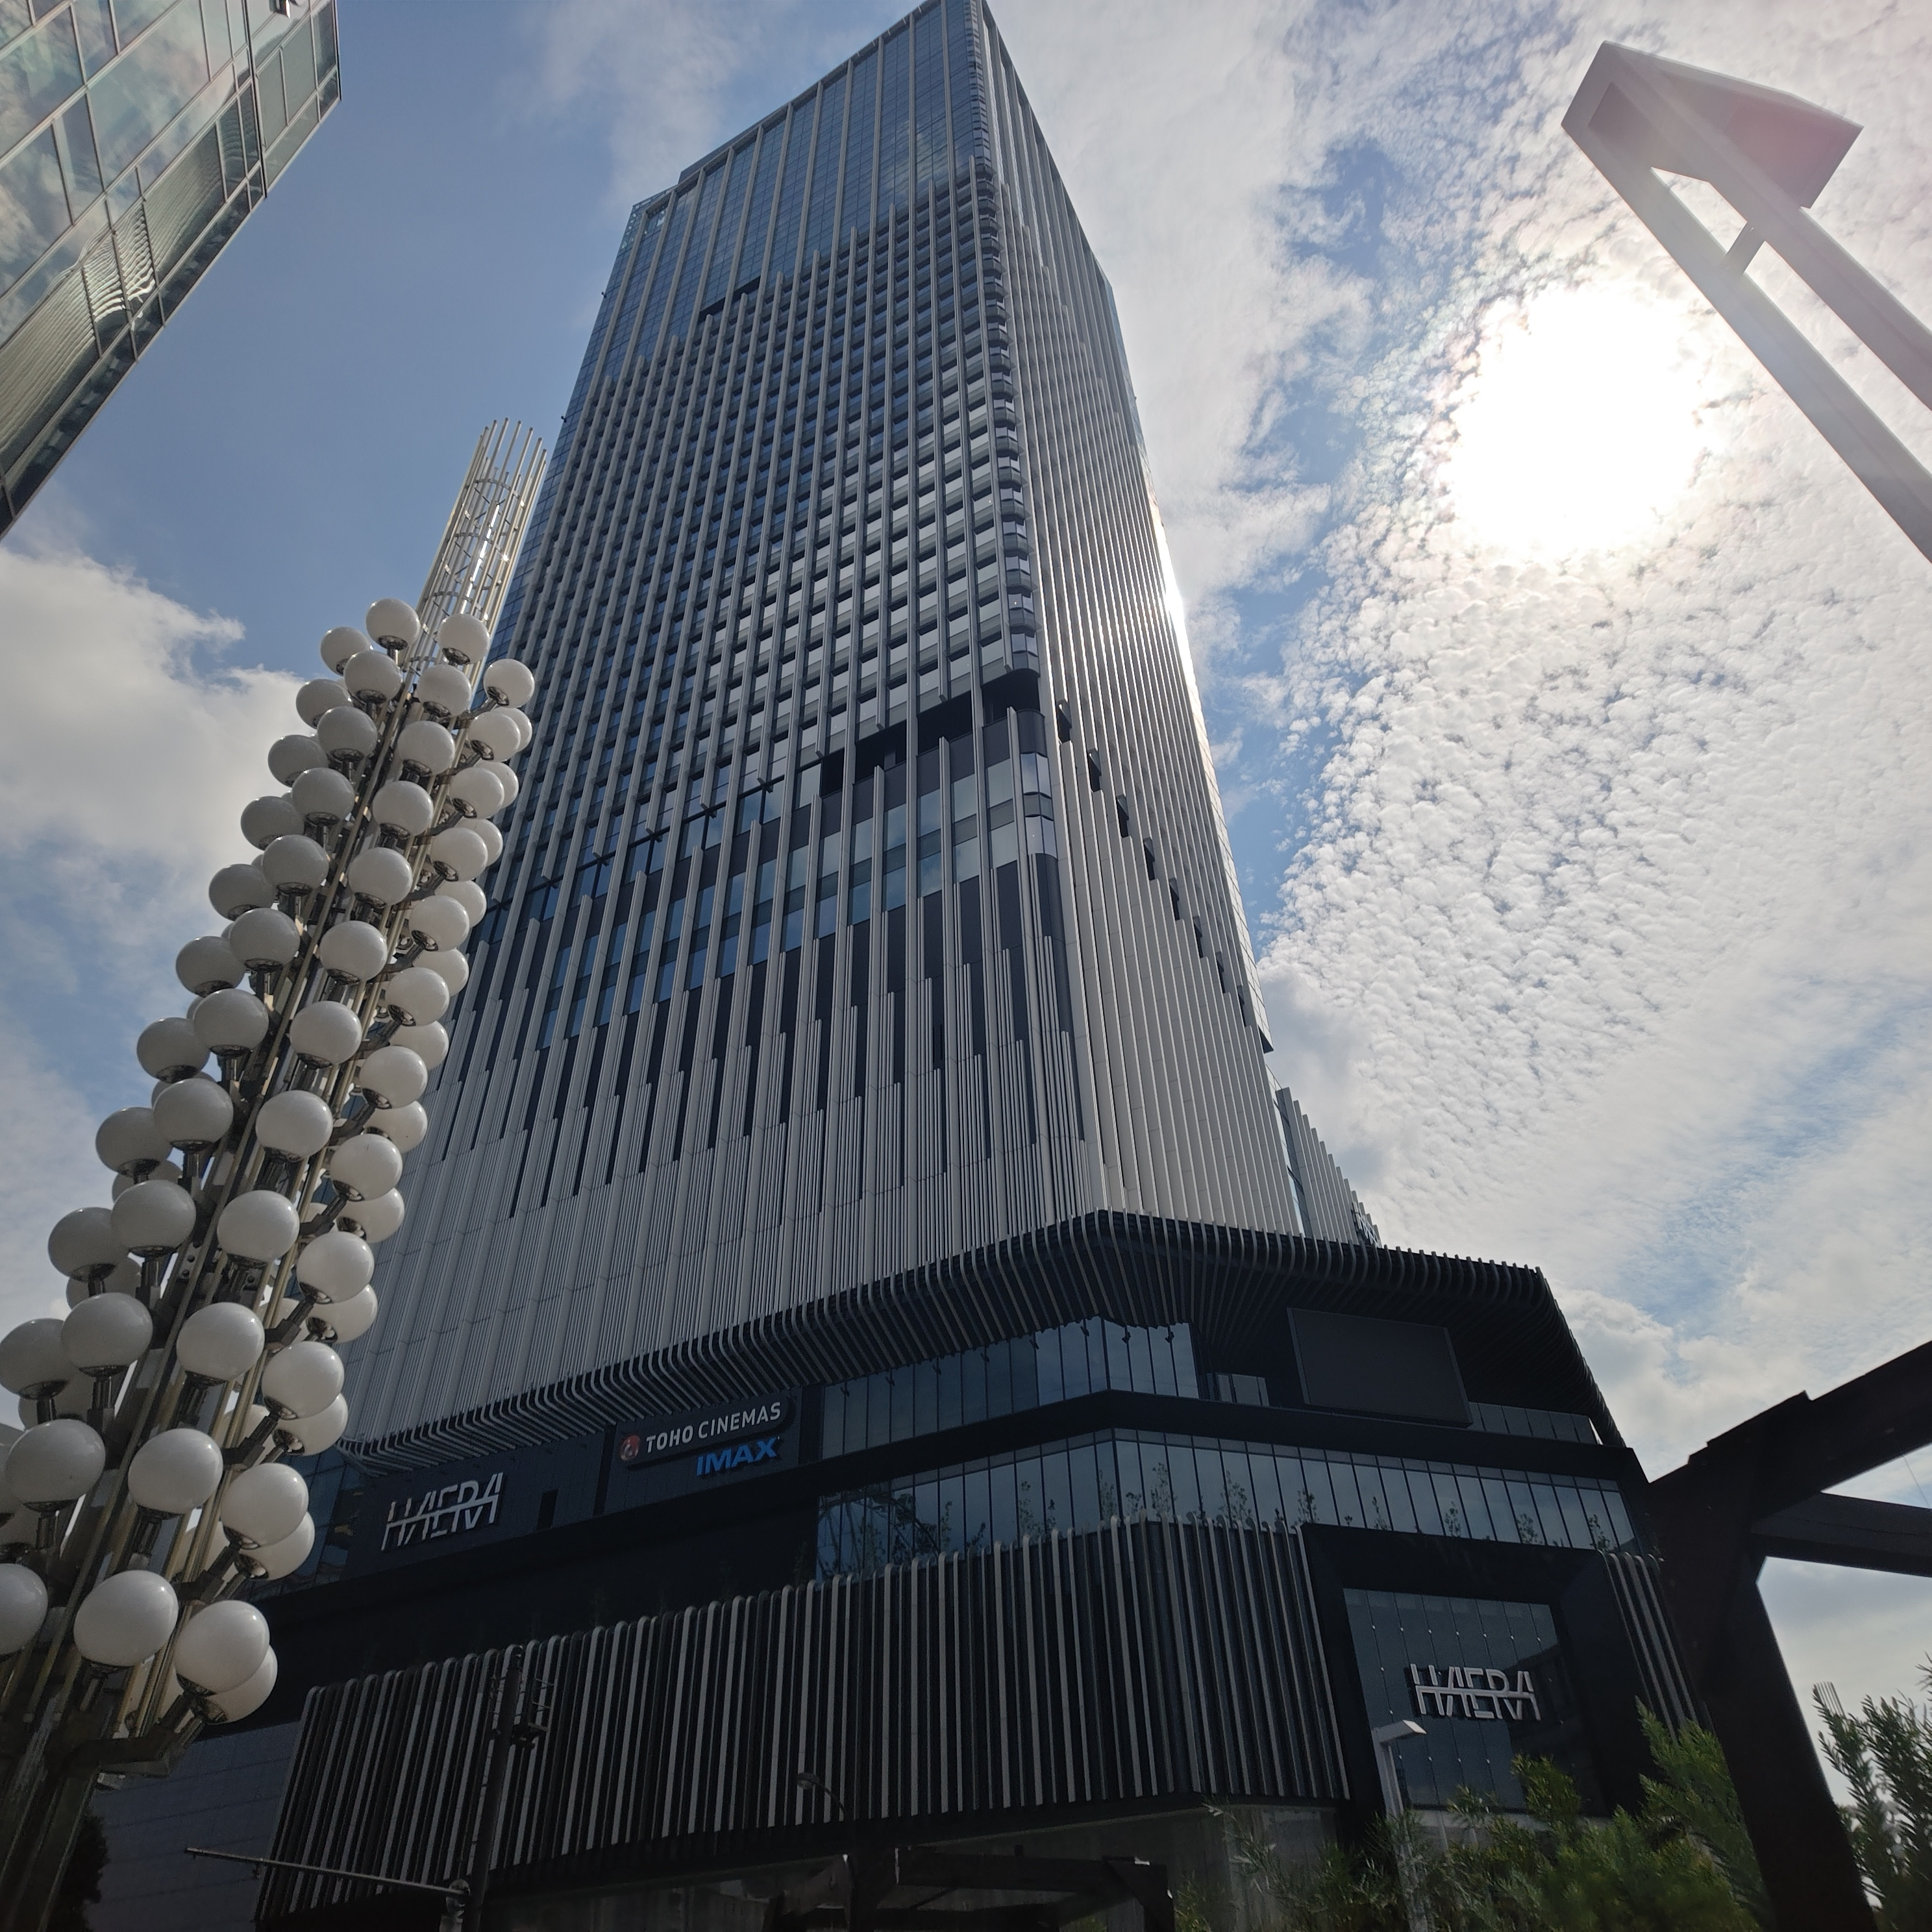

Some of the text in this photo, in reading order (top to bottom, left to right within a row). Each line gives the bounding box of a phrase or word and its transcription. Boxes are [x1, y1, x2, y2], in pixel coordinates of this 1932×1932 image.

[646, 1402, 780, 1453] TOHO CINEMAS
[696, 1436, 778, 1476] IMAX
[381, 1472, 503, 1551] HAERA
[1410, 1663, 1541, 1721] HAERA
